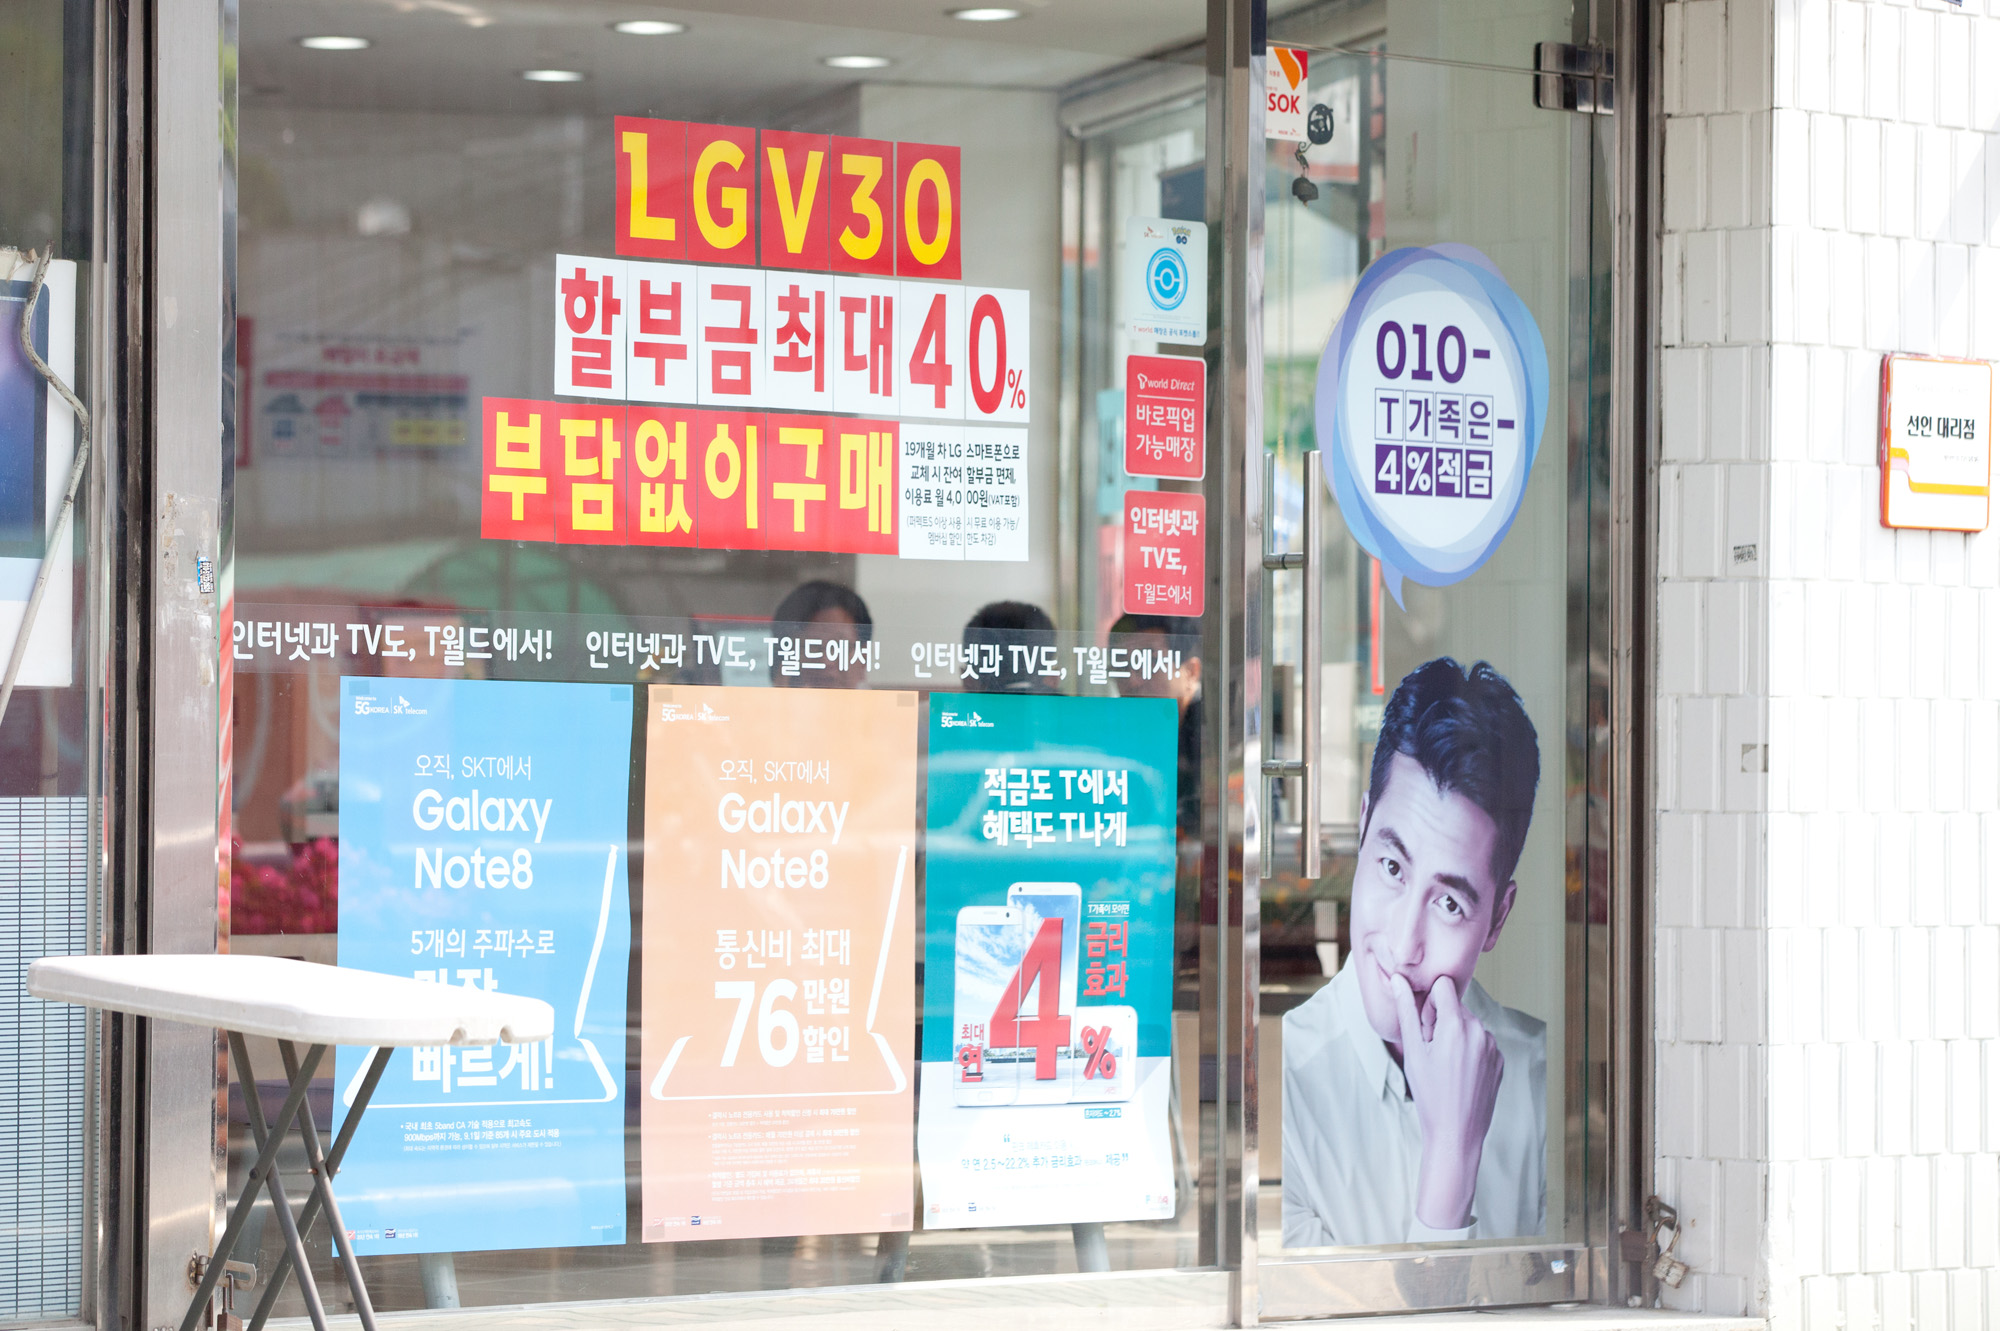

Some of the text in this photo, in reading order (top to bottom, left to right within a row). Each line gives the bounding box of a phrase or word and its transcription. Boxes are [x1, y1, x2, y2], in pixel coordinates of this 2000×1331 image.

[1265, 92, 1300, 115] SOK
[1170, 379, 1195, 391] Direct
[1136, 404, 1195, 433] 바로픽업
[1907, 415, 1975, 440] 선인 대리점
[905, 441, 1020, 461] 19개월 차 LG 스마트폰으로
[1136, 433, 1196, 462] 가능매장
[911, 465, 930, 482] 교체
[932, 466, 941, 483] 시
[943, 467, 962, 484] 잔여
[966, 466, 994, 485] 할부금
[905, 488, 932, 507] 이용료
[935, 489, 944, 508] 월
[1130, 506, 1199, 536] 인터넷과
[1140, 546, 1188, 575] TV도,
[1134, 582, 1192, 605] T월드에서
[232, 620, 553, 667] 인터넷과 TV도, T월드에서!
[585, 630, 881, 676] 인터넷과 TV도, T월드에서!
[910, 641, 1181, 685] 인터넷과 TV도, T월드에서!
[405, 707, 428, 715] telecom
[414, 753, 532, 781] 오직, SKT에서
[719, 759, 830, 785] 오직, SKT에서
[984, 767, 1129, 807] 적금도 T에서
[412, 788, 553, 844] Galaxy
[717, 792, 850, 846] Galaxy
[982, 810, 1128, 849] 혜택도 T나게
[414, 846, 534, 890] Note8
[721, 848, 830, 889] Note8
[411, 928, 556, 958] 5개의 주파수로
[714, 928, 851, 970] 통신비 최대
[1086, 921, 1128, 958] 금리
[1083, 961, 1129, 998] 효과
[802, 977, 850, 1015] 만원
[802, 1025, 850, 1064] 할인
[961, 1023, 985, 1041] 최대
[958, 1043, 984, 1083] 연
[405, 1121, 419, 1131] 국내
